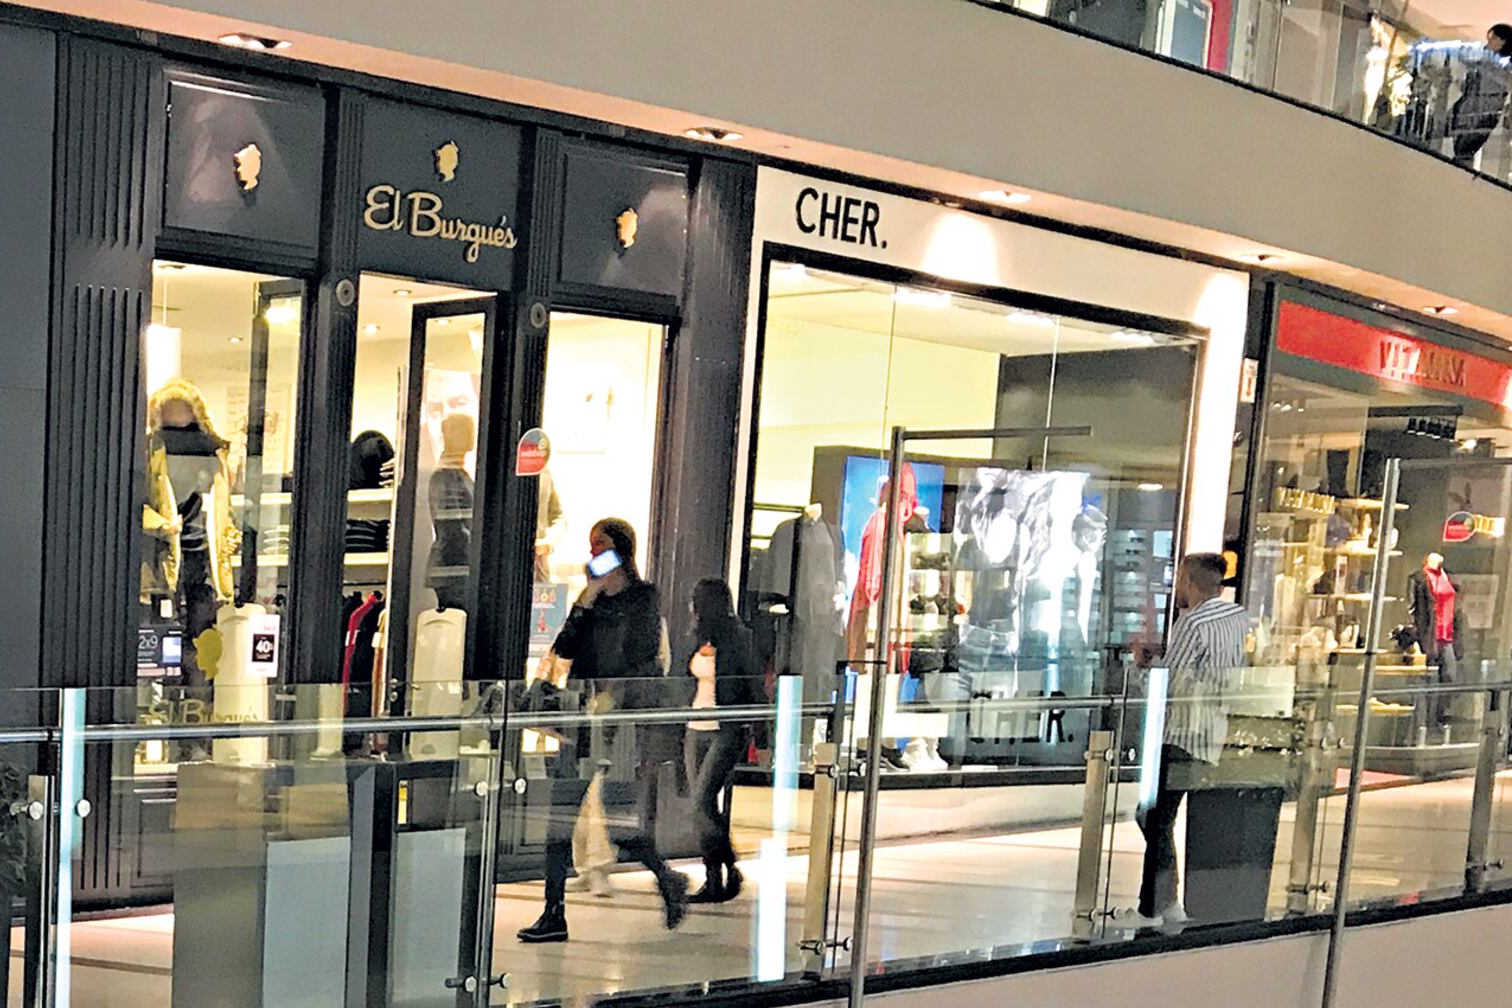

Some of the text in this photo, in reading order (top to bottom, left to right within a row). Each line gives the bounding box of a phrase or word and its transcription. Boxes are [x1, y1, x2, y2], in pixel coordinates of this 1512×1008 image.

[363, 184, 518, 263] El Burgués
[795, 187, 887, 249] CHER.
